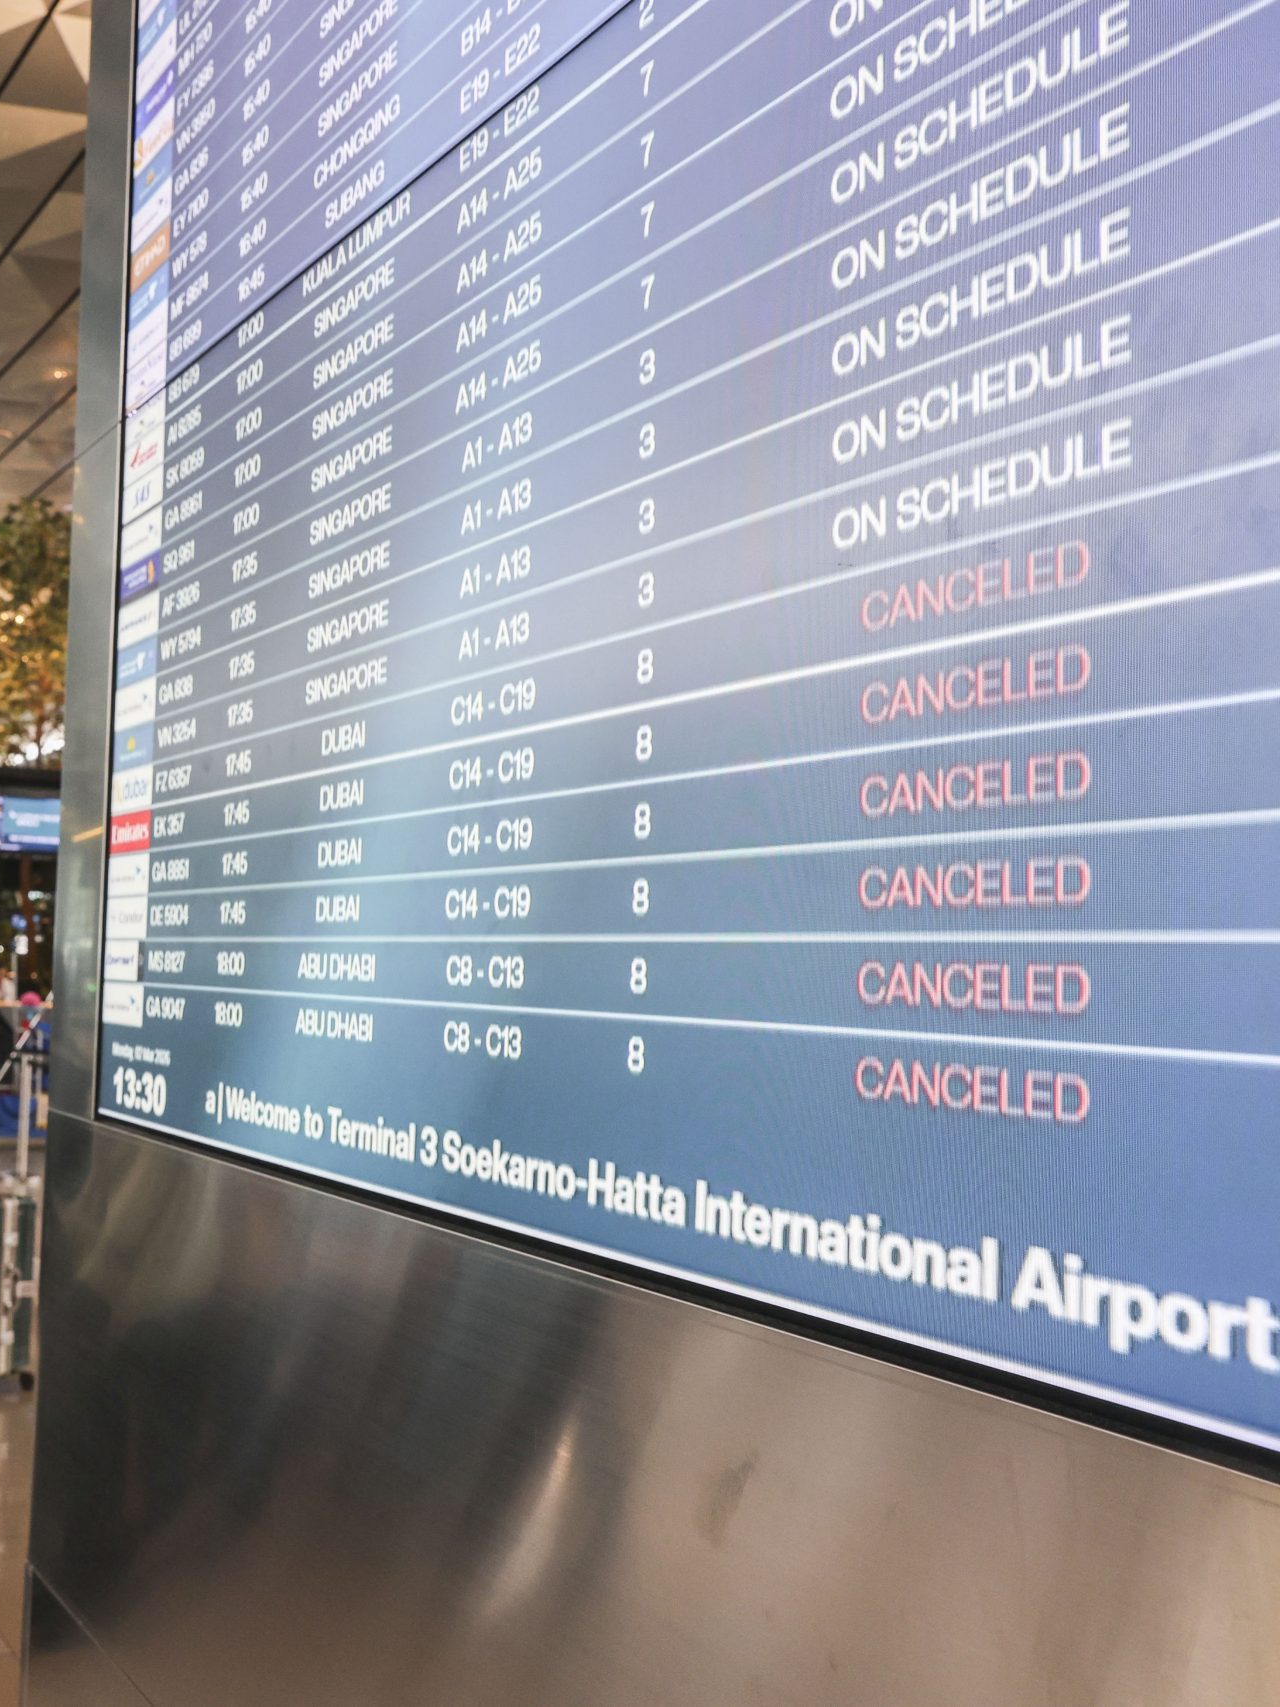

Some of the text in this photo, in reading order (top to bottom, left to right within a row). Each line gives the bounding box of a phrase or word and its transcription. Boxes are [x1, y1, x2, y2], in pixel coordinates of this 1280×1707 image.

[314, 94, 400, 189] CHONGQING
[318, 40, 398, 138] SINGAPORE
[319, 0, 398, 87] SINGAPORE
[325, 160, 384, 228] SUBANG
[460, 68, 489, 114] E19
[504, 23, 540, 77] E22
[233, 502, 260, 536] 17:00
[311, 424, 393, 492] SINGAPORE
[455, 371, 487, 415] A14
[502, 339, 542, 389] A25
[640, 273, 655, 312] 7
[831, 141, 884, 204] ON
[894, 2, 1130, 171] SCHEDULE
[234, 453, 261, 488] 17:00
[312, 368, 393, 440] SINGAPORE
[456, 309, 487, 353] A14
[503, 273, 542, 325] A25
[640, 200, 655, 238] 7
[830, 54, 884, 120] ON
[236, 406, 262, 442] 17:00
[313, 314, 394, 389] SINGAPORE
[457, 248, 488, 295] A14
[504, 210, 542, 262] A25
[640, 129, 655, 168] 7
[237, 310, 264, 348] 17:00
[302, 245, 346, 297] KUALA
[348, 191, 410, 260] LUMPUR
[459, 128, 488, 173] E19
[503, 85, 540, 138] E22
[639, 0, 654, 30] 2
[237, 59, 655, 395] 17:00 SINGAPORE A14 A25 7
[161, 639, 178, 661] WY
[230, 600, 256, 632] 17:35
[308, 540, 390, 599] SINGAPORE
[460, 499, 482, 536] A1
[497, 478, 532, 520] A13
[639, 422, 656, 459] 3
[831, 318, 885, 376] ON
[896, 206, 1131, 350] SCHEDULE
[232, 551, 258, 583] 17:35
[310, 482, 391, 546] SINGAPORE
[462, 436, 483, 474] A1
[498, 411, 532, 455] A13
[639, 348, 656, 385] 3
[831, 229, 885, 291] ON
[895, 102, 1131, 260] SCHEDULE
[157, 727, 172, 749] VN
[227, 699, 253, 728] 17:35
[306, 657, 388, 705] SINGAPORE
[458, 627, 479, 662] A1
[495, 611, 530, 650] A13
[638, 571, 655, 609] 3
[832, 496, 886, 550] ON
[896, 417, 1132, 531] SCHEDULE
[158, 683, 174, 705] GA
[229, 651, 255, 680] 17:35
[307, 599, 389, 653] SINGAPORE
[459, 563, 481, 600] A1
[496, 545, 531, 587] A13
[638, 498, 655, 534] 3
[832, 408, 886, 464] ON
[896, 314, 1132, 441] SCHEDULE
[153, 816, 166, 838] EK
[224, 800, 250, 827] 17:45
[320, 779, 364, 812] DUBAI
[448, 756, 482, 791] C14
[497, 746, 535, 783] C19
[635, 724, 653, 763] 8
[861, 644, 1091, 725] CANCELED
[156, 771, 167, 793] FZ
[226, 749, 251, 776] 17:45
[321, 721, 365, 756] DUBAI
[451, 690, 484, 726] C14
[499, 678, 536, 715] C19
[637, 648, 654, 685] 8
[861, 539, 1090, 632] CANCELED
[150, 905, 164, 927] DE
[220, 900, 246, 924] 17:45
[316, 894, 360, 922] DUBAI
[444, 887, 478, 920] C14
[493, 884, 531, 920] C19
[632, 877, 650, 917] 8
[859, 855, 1091, 910] CANCELED
[152, 860, 166, 882] GA
[222, 851, 247, 876] 17:45
[317, 838, 362, 868] DUBAI
[446, 822, 480, 856] C14
[495, 817, 533, 852] C19
[634, 801, 651, 840] 8
[860, 751, 1091, 818] CANCELED
[113, 1066, 166, 1117] 13:30
[146, 995, 161, 1018] GA
[215, 1002, 242, 1027] 18:00
[296, 1008, 324, 1037] ABU
[327, 1010, 373, 1043] DHABI
[443, 1020, 470, 1054] C8
[485, 1024, 522, 1060] C13
[627, 1035, 645, 1075] 8
[855, 1055, 1090, 1124] CANCELED
[148, 950, 164, 972] MS
[217, 951, 245, 975] 18:00
[297, 953, 326, 980] ABU
[329, 953, 375, 982] DHABI
[446, 955, 472, 986] C8
[488, 955, 525, 989] C13
[630, 956, 647, 995] 8
[857, 961, 1091, 1015] CANCELED
[205, 1090, 1280, 1372] a Welcome to Terminal 3 Soekarno-Hatta International Airport
